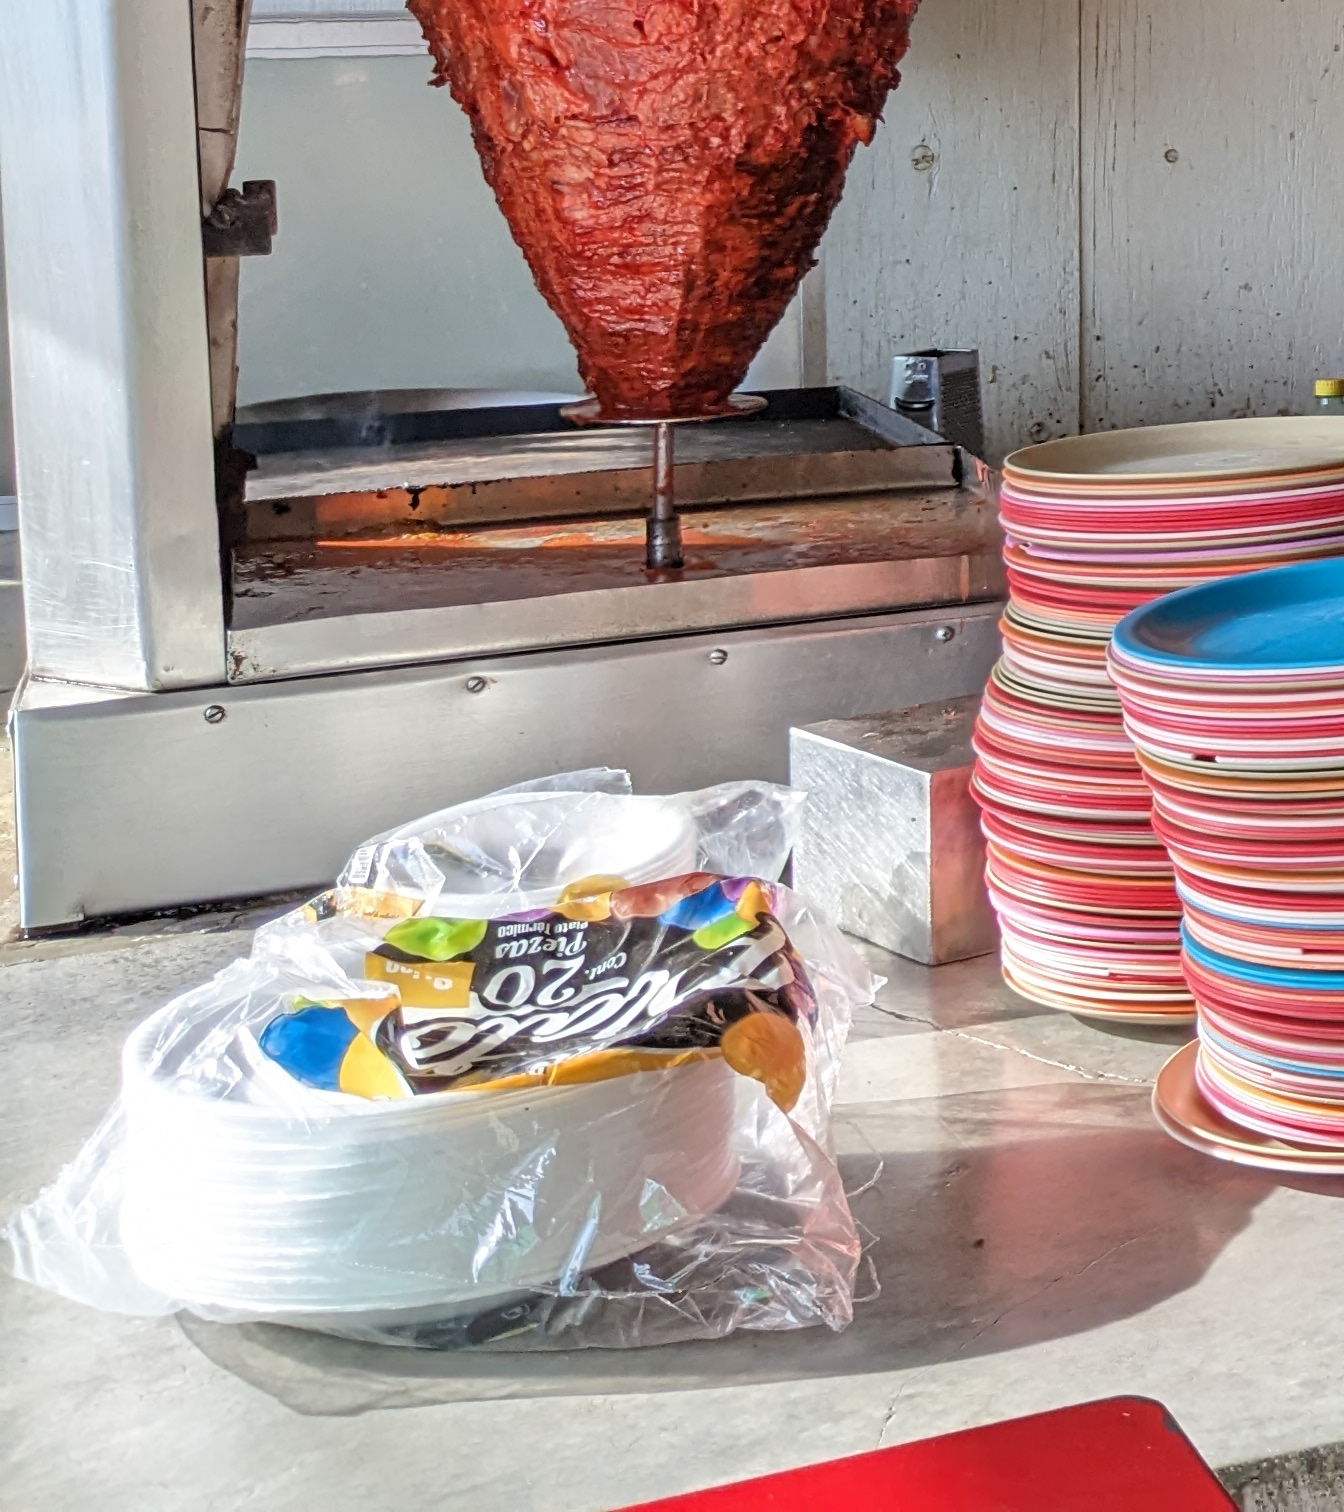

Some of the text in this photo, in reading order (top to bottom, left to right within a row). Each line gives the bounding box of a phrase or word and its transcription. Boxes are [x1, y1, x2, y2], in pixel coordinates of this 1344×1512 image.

[494, 928, 589, 961] Piezas
[482, 953, 586, 1010] 20
[583, 950, 628, 982] Cont.
